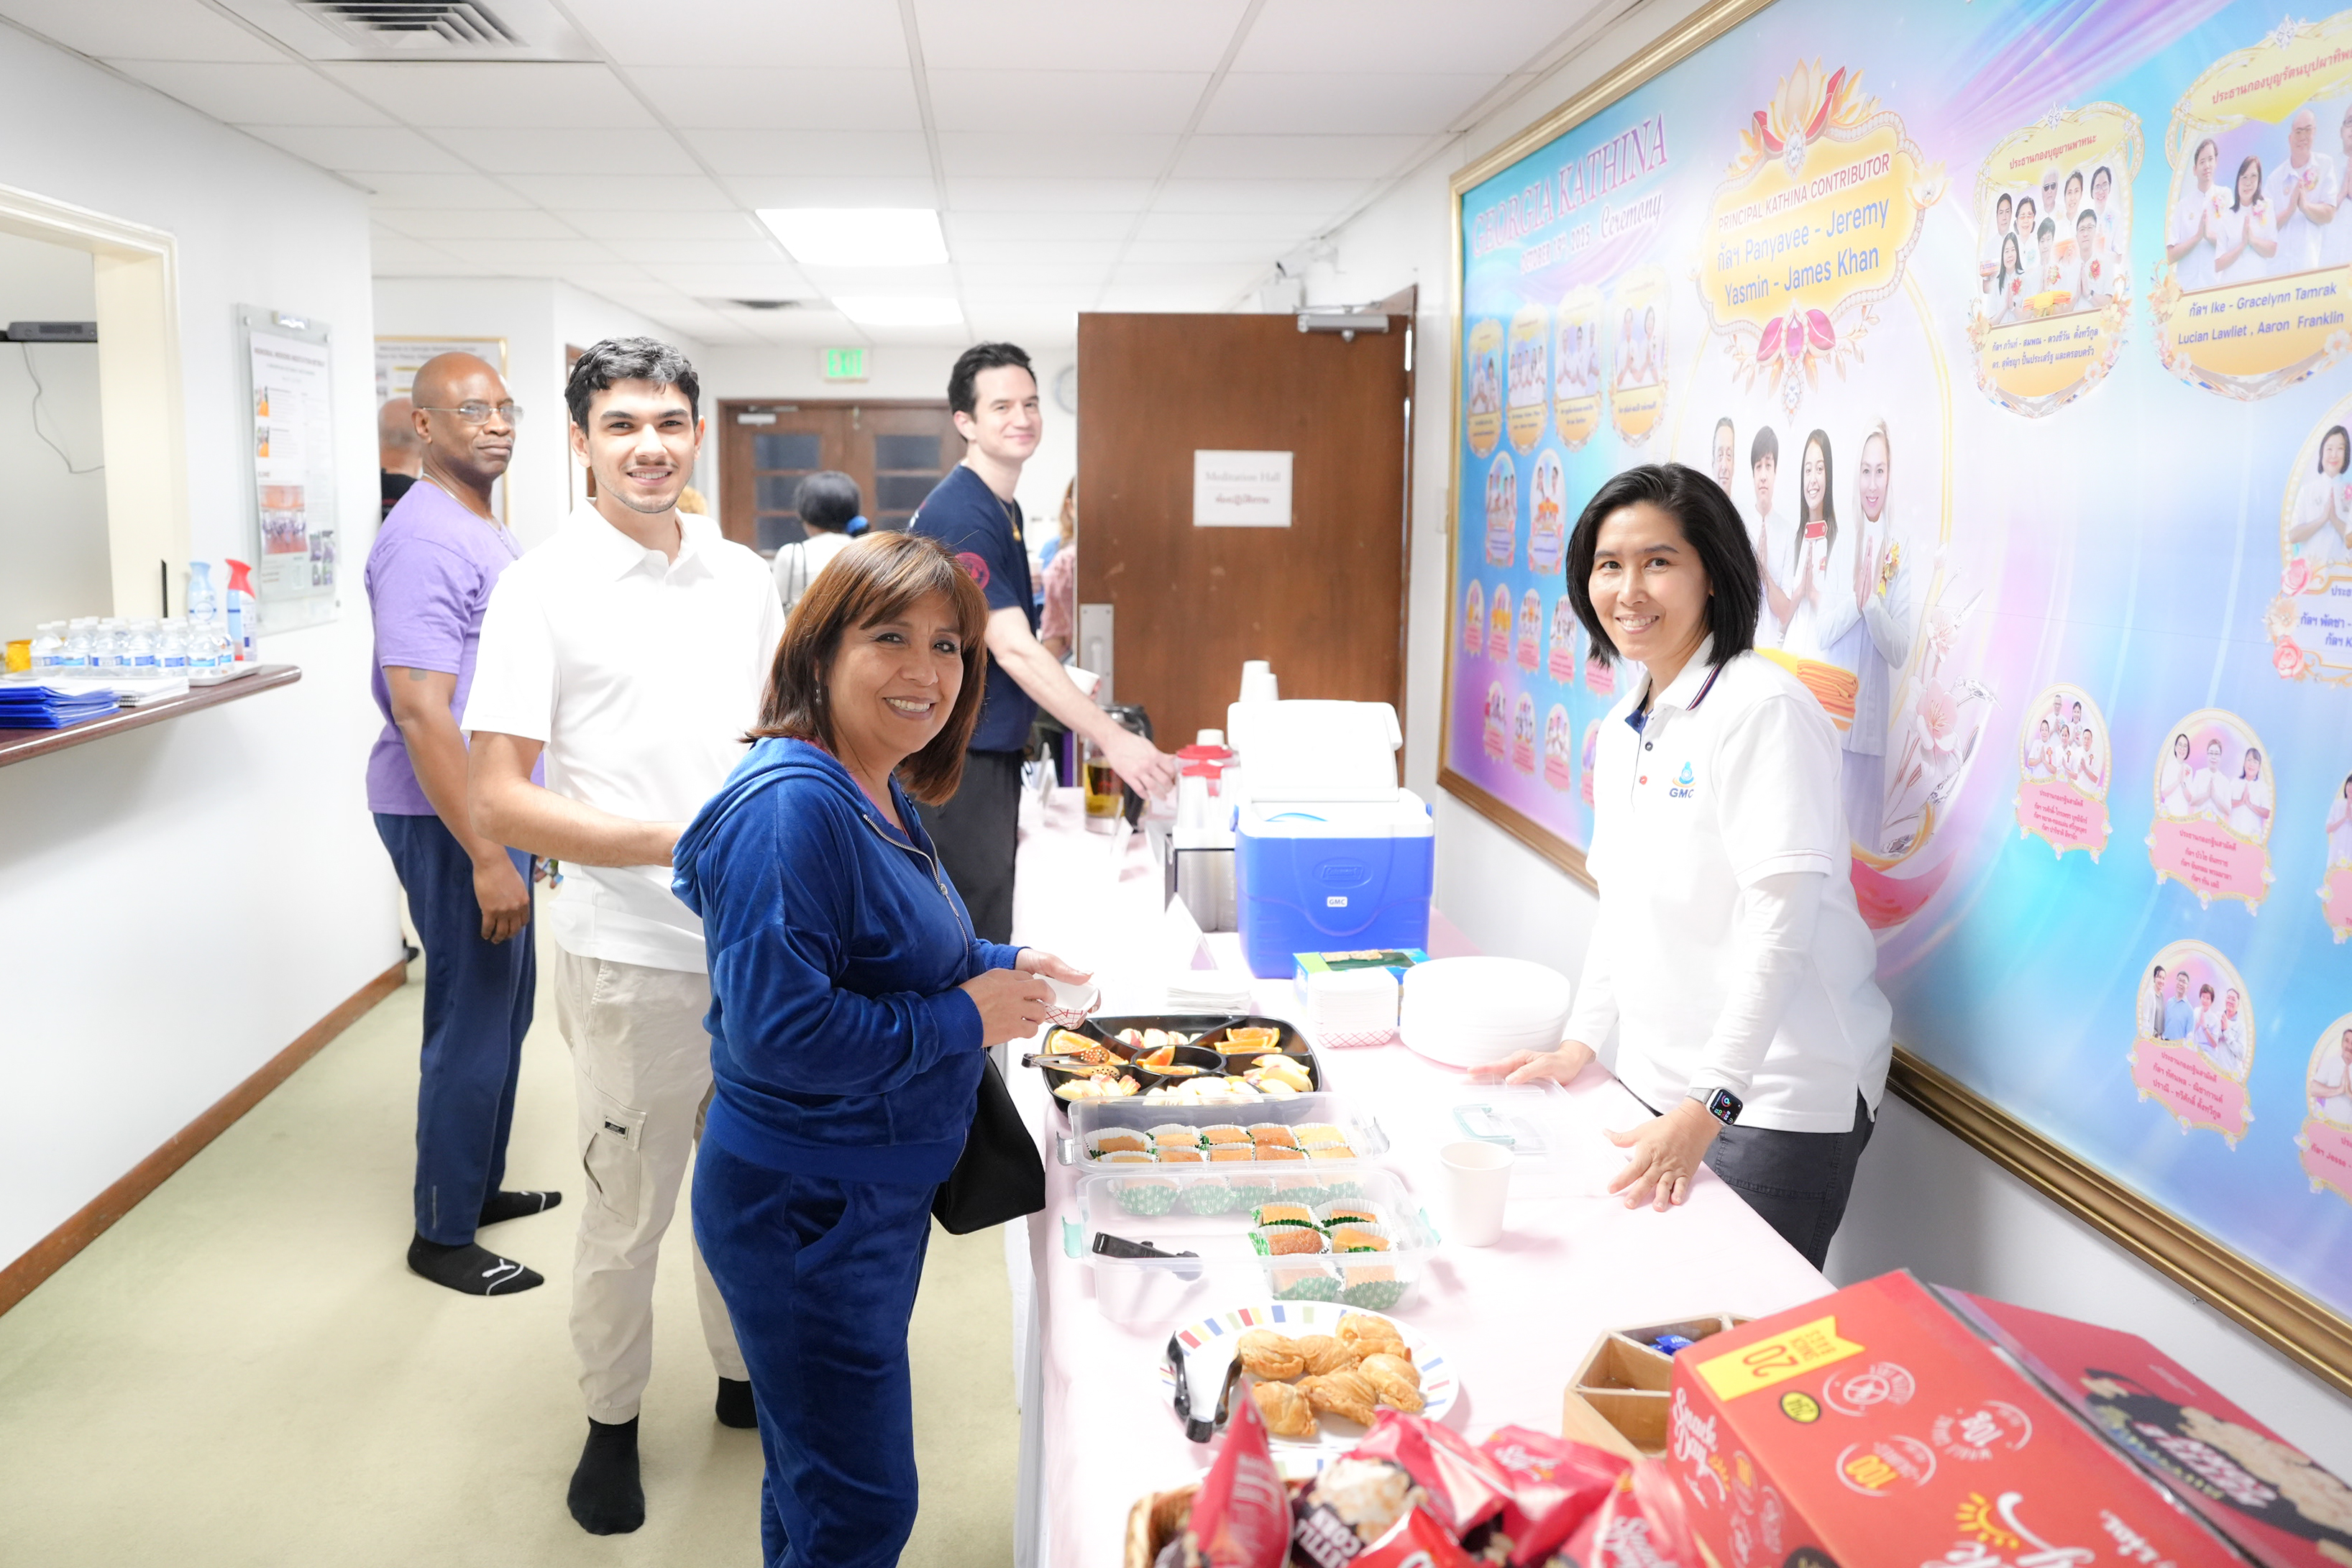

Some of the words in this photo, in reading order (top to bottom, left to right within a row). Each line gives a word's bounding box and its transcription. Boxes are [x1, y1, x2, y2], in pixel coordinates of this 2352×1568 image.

[2010, 134, 2097, 170] ประธานกองบุญยานพาหนะ
[1473, 178, 1554, 257] GEORGIA
[1558, 113, 1667, 217] KATHINA
[1719, 203, 1762, 233] PRINCIPAL
[1766, 185, 1808, 216] KATHINA
[1811, 153, 1890, 198] CONTRIBUTOR
[1601, 193, 1662, 239] Ceremony
[1718, 242, 1739, 272] กัลฯ
[1745, 226, 1809, 262] Panyavee
[1826, 198, 1889, 237] Jeremy
[1725, 275, 1769, 306] Yasmin
[1784, 261, 1831, 291] James
[1837, 247, 1879, 278] Khan
[2189, 303, 2207, 317] กัลฯ
[2211, 301, 2225, 314] Ike
[2237, 292, 2291, 310] Gracelynn
[2295, 282, 2336, 300] Tamrak
[2178, 331, 2209, 345] Lucian
[2212, 324, 2248, 341] Lawliet
[2257, 320, 2289, 334] Aaron
[2297, 311, 2344, 329] Franklin
[828, 349, 862, 377] EXIT
[1205, 472, 1258, 482] Meditation
[1260, 472, 1281, 482] Hall
[1669, 787, 1694, 799] GMC
[1742, 1344, 1800, 1377] 20
[1844, 1454, 1898, 1491] 100
